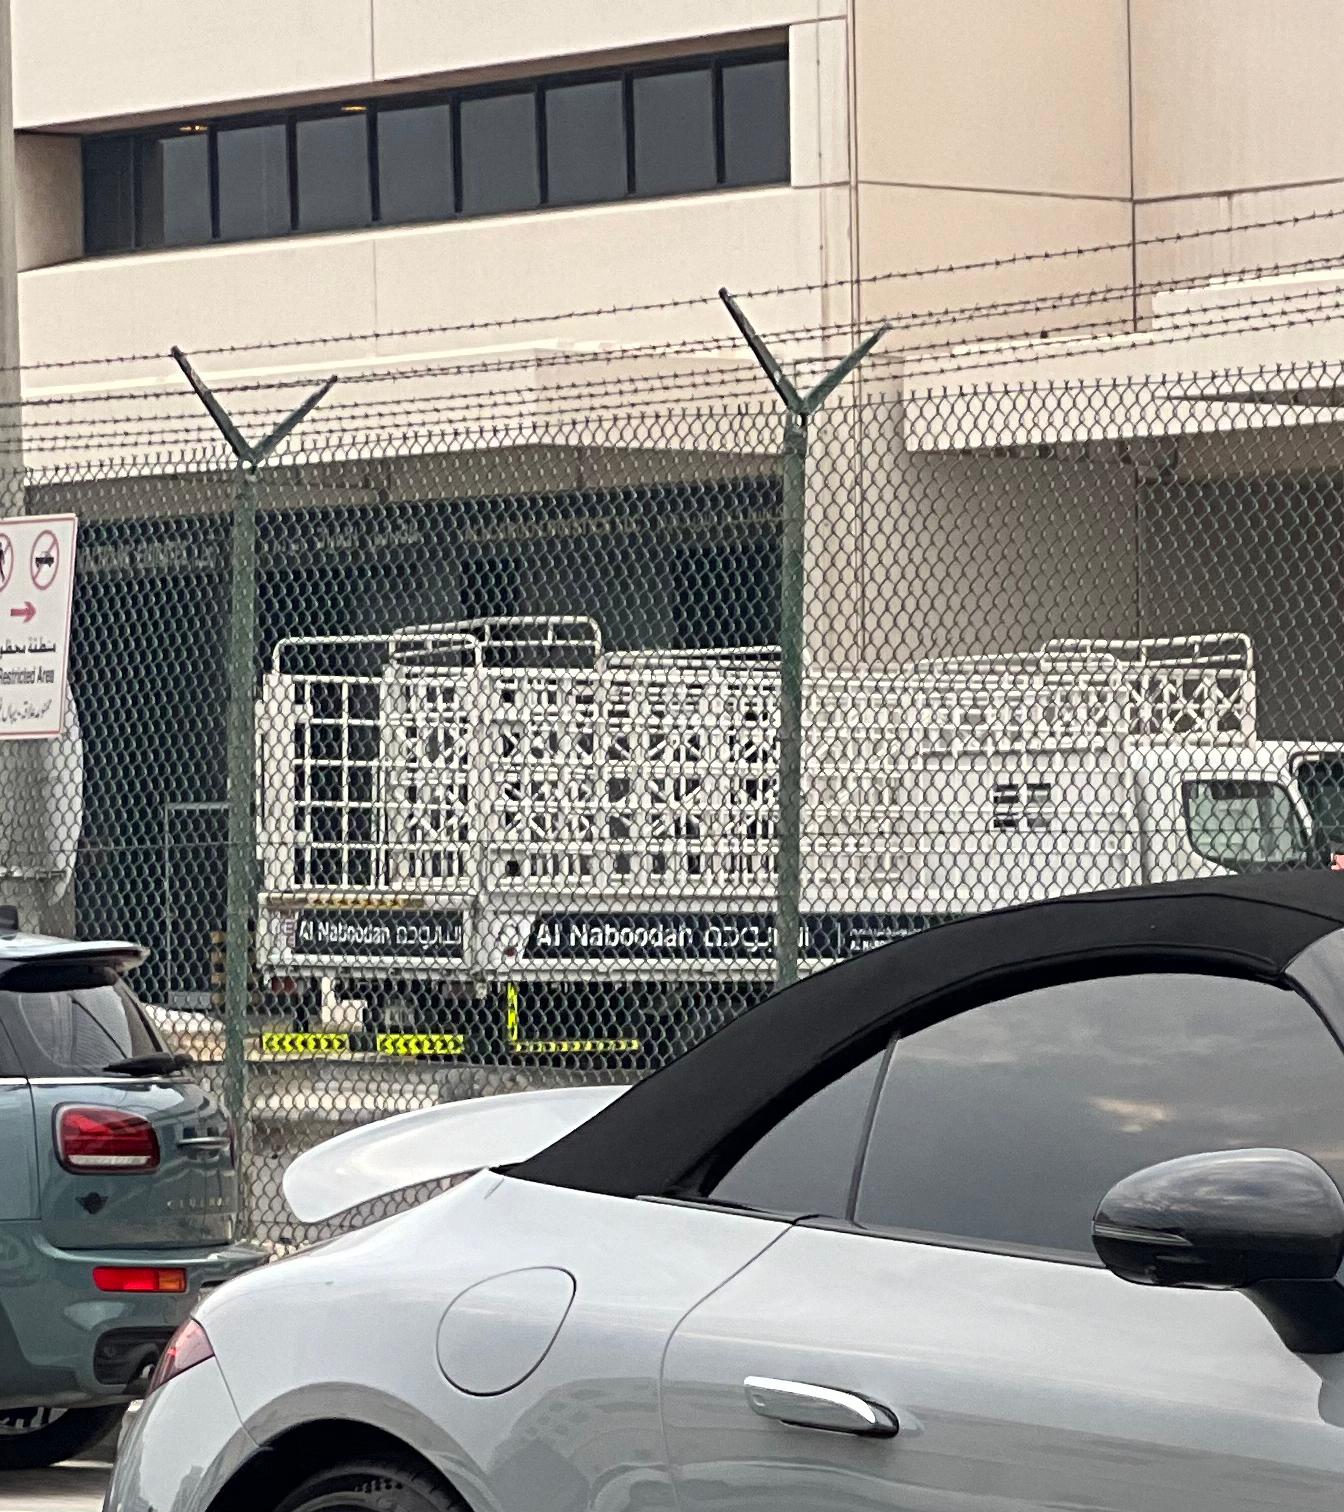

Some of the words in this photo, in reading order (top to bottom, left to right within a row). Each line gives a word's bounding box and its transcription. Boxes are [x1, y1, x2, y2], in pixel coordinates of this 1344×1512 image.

[36, 665, 55, 684] Area
[299, 920, 314, 941] Al
[537, 924, 560, 947] Al
[570, 923, 693, 948] Naboodah
